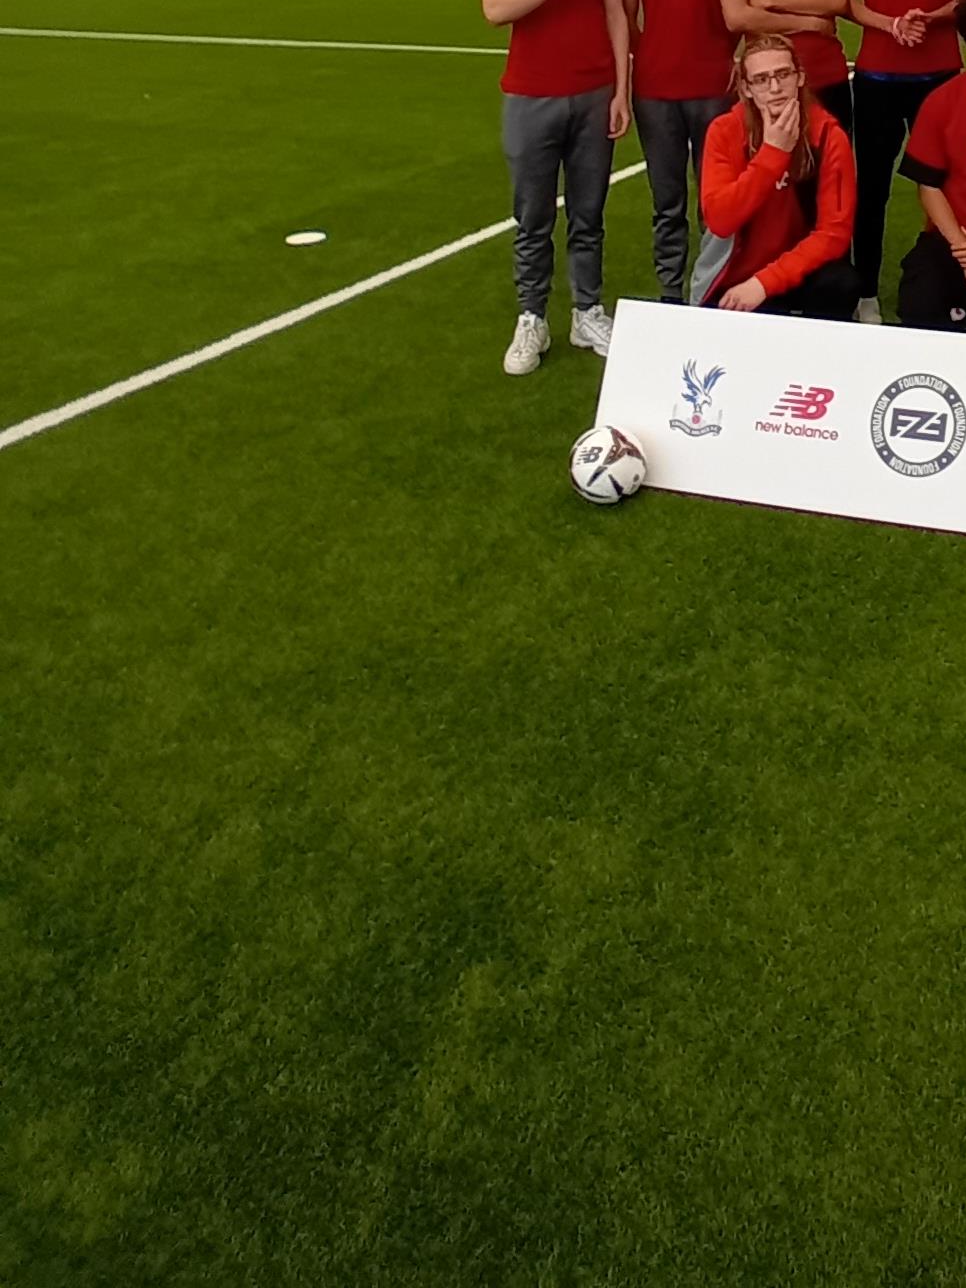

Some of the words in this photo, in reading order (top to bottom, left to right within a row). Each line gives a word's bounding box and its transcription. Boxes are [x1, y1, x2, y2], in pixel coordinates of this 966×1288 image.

[897, 374, 950, 394] FOUNDATION
[755, 421, 782, 433] new
[784, 422, 839, 441] balance
[872, 394, 891, 449] FOUNDATION
[946, 401, 966, 457] FOUNDATION
